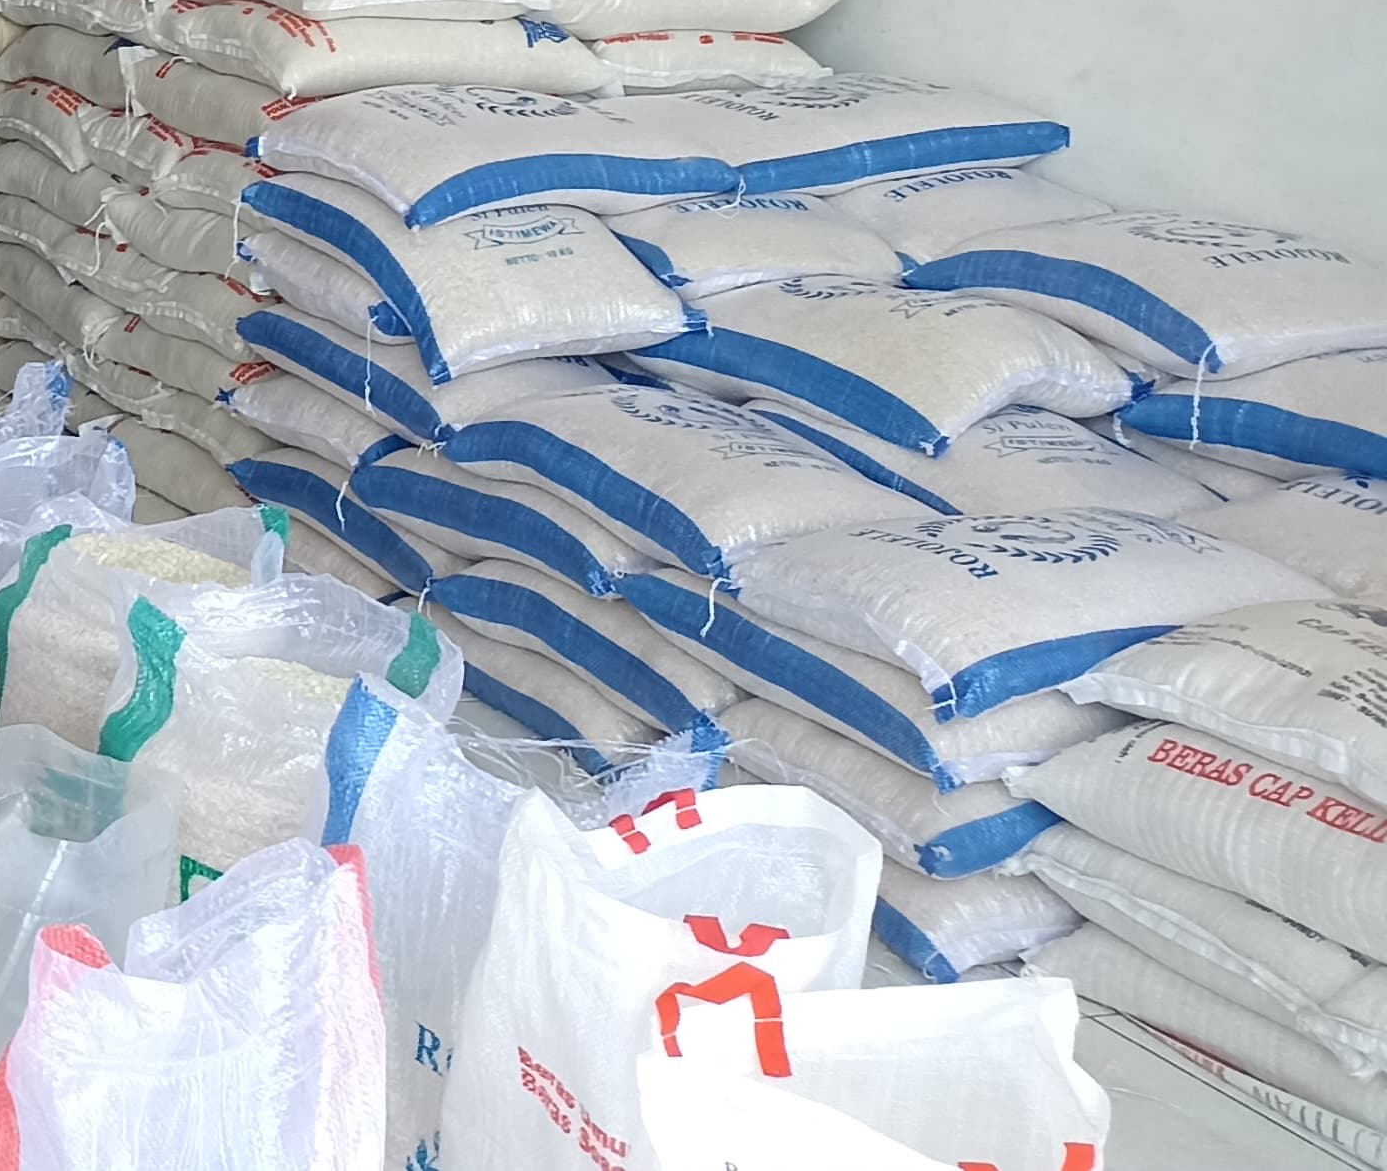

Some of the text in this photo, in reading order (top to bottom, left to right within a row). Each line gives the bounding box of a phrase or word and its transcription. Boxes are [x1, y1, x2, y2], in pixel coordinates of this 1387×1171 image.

[883, 169, 1013, 203] ROJOLELE
[848, 527, 999, 580] ROJOLELE
[1147, 738, 1254, 786] BERAS
[1248, 772, 1315, 808] CAP
